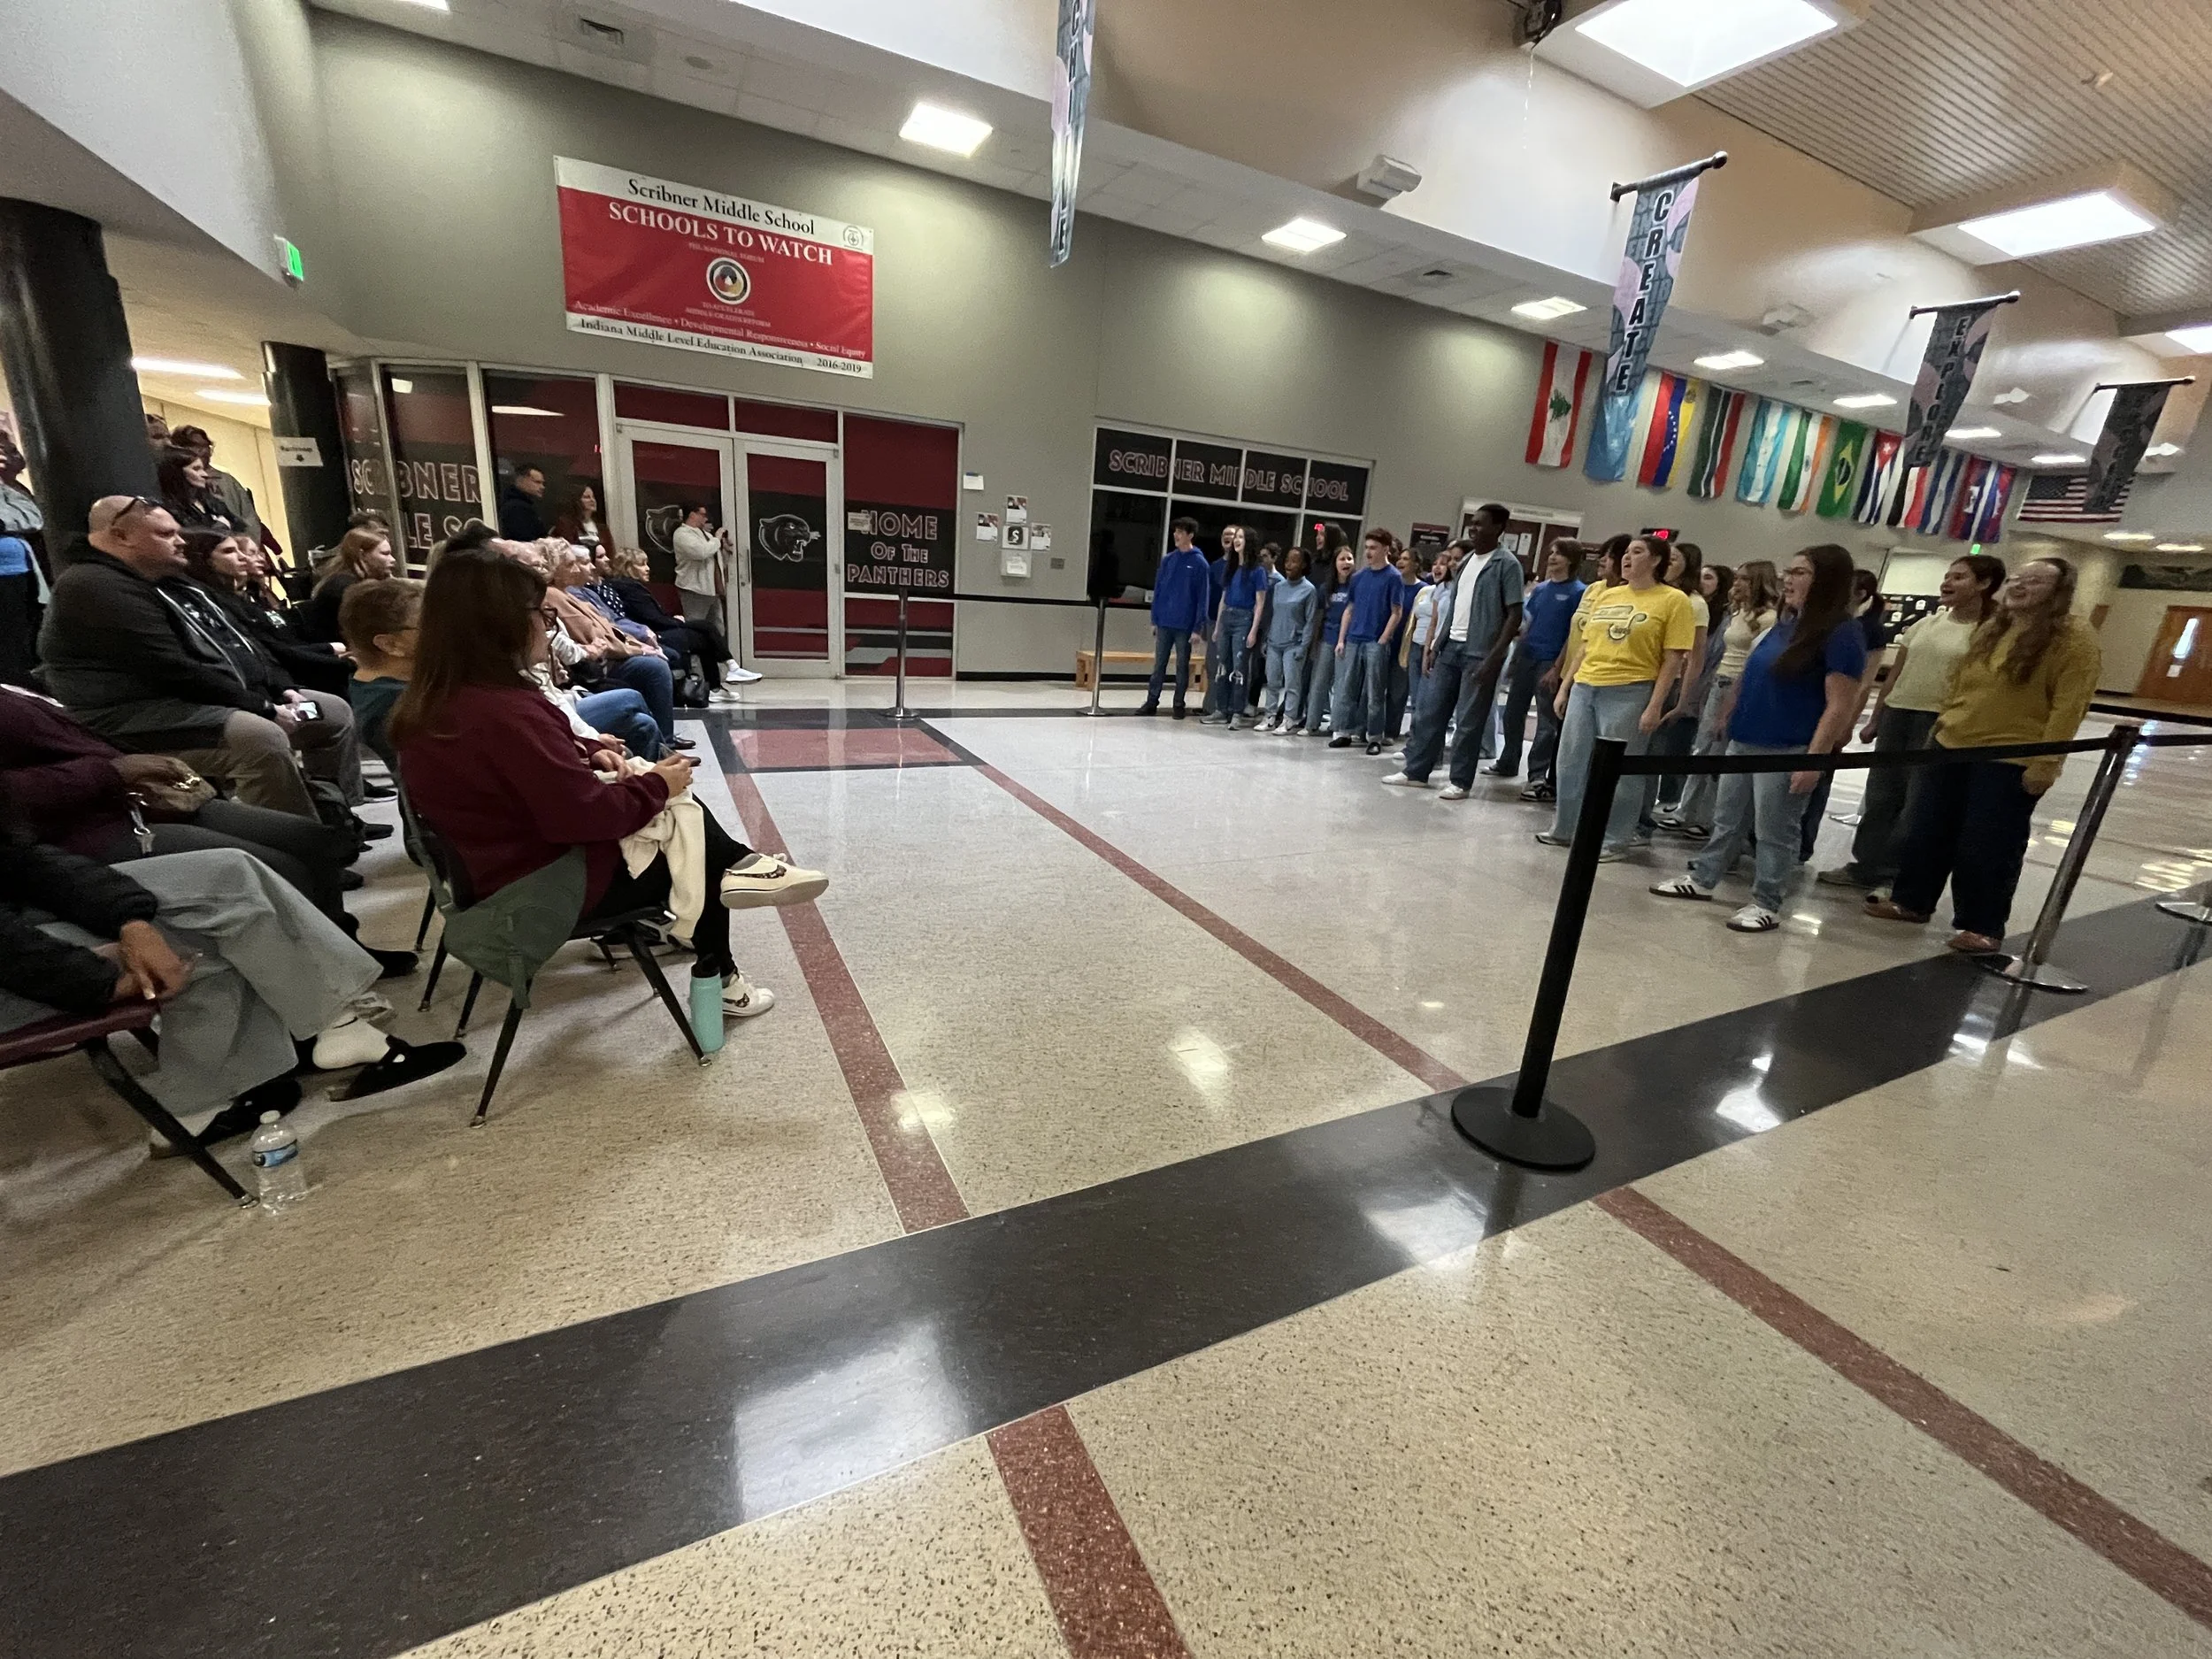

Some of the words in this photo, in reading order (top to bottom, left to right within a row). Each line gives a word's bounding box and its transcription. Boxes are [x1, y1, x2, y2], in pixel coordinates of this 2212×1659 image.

[609, 202, 718, 240] SCHOOLS
[723, 227, 753, 248] TO
[758, 234, 833, 265] WATCH
[628, 179, 697, 208] Scribner
[703, 196, 760, 222] Middle
[764, 210, 814, 234] School
[574, 301, 620, 315] Academic
[1616, 189, 1675, 392] CREATE
[580, 319, 623, 334] Indiana
[626, 326, 664, 341] Middle
[667, 333, 694, 346] Level
[696, 338, 746, 355] Education
[749, 347, 803, 364] Association
[817, 357, 862, 373] 2016-2019
[848, 564, 949, 588] PANTHERS
